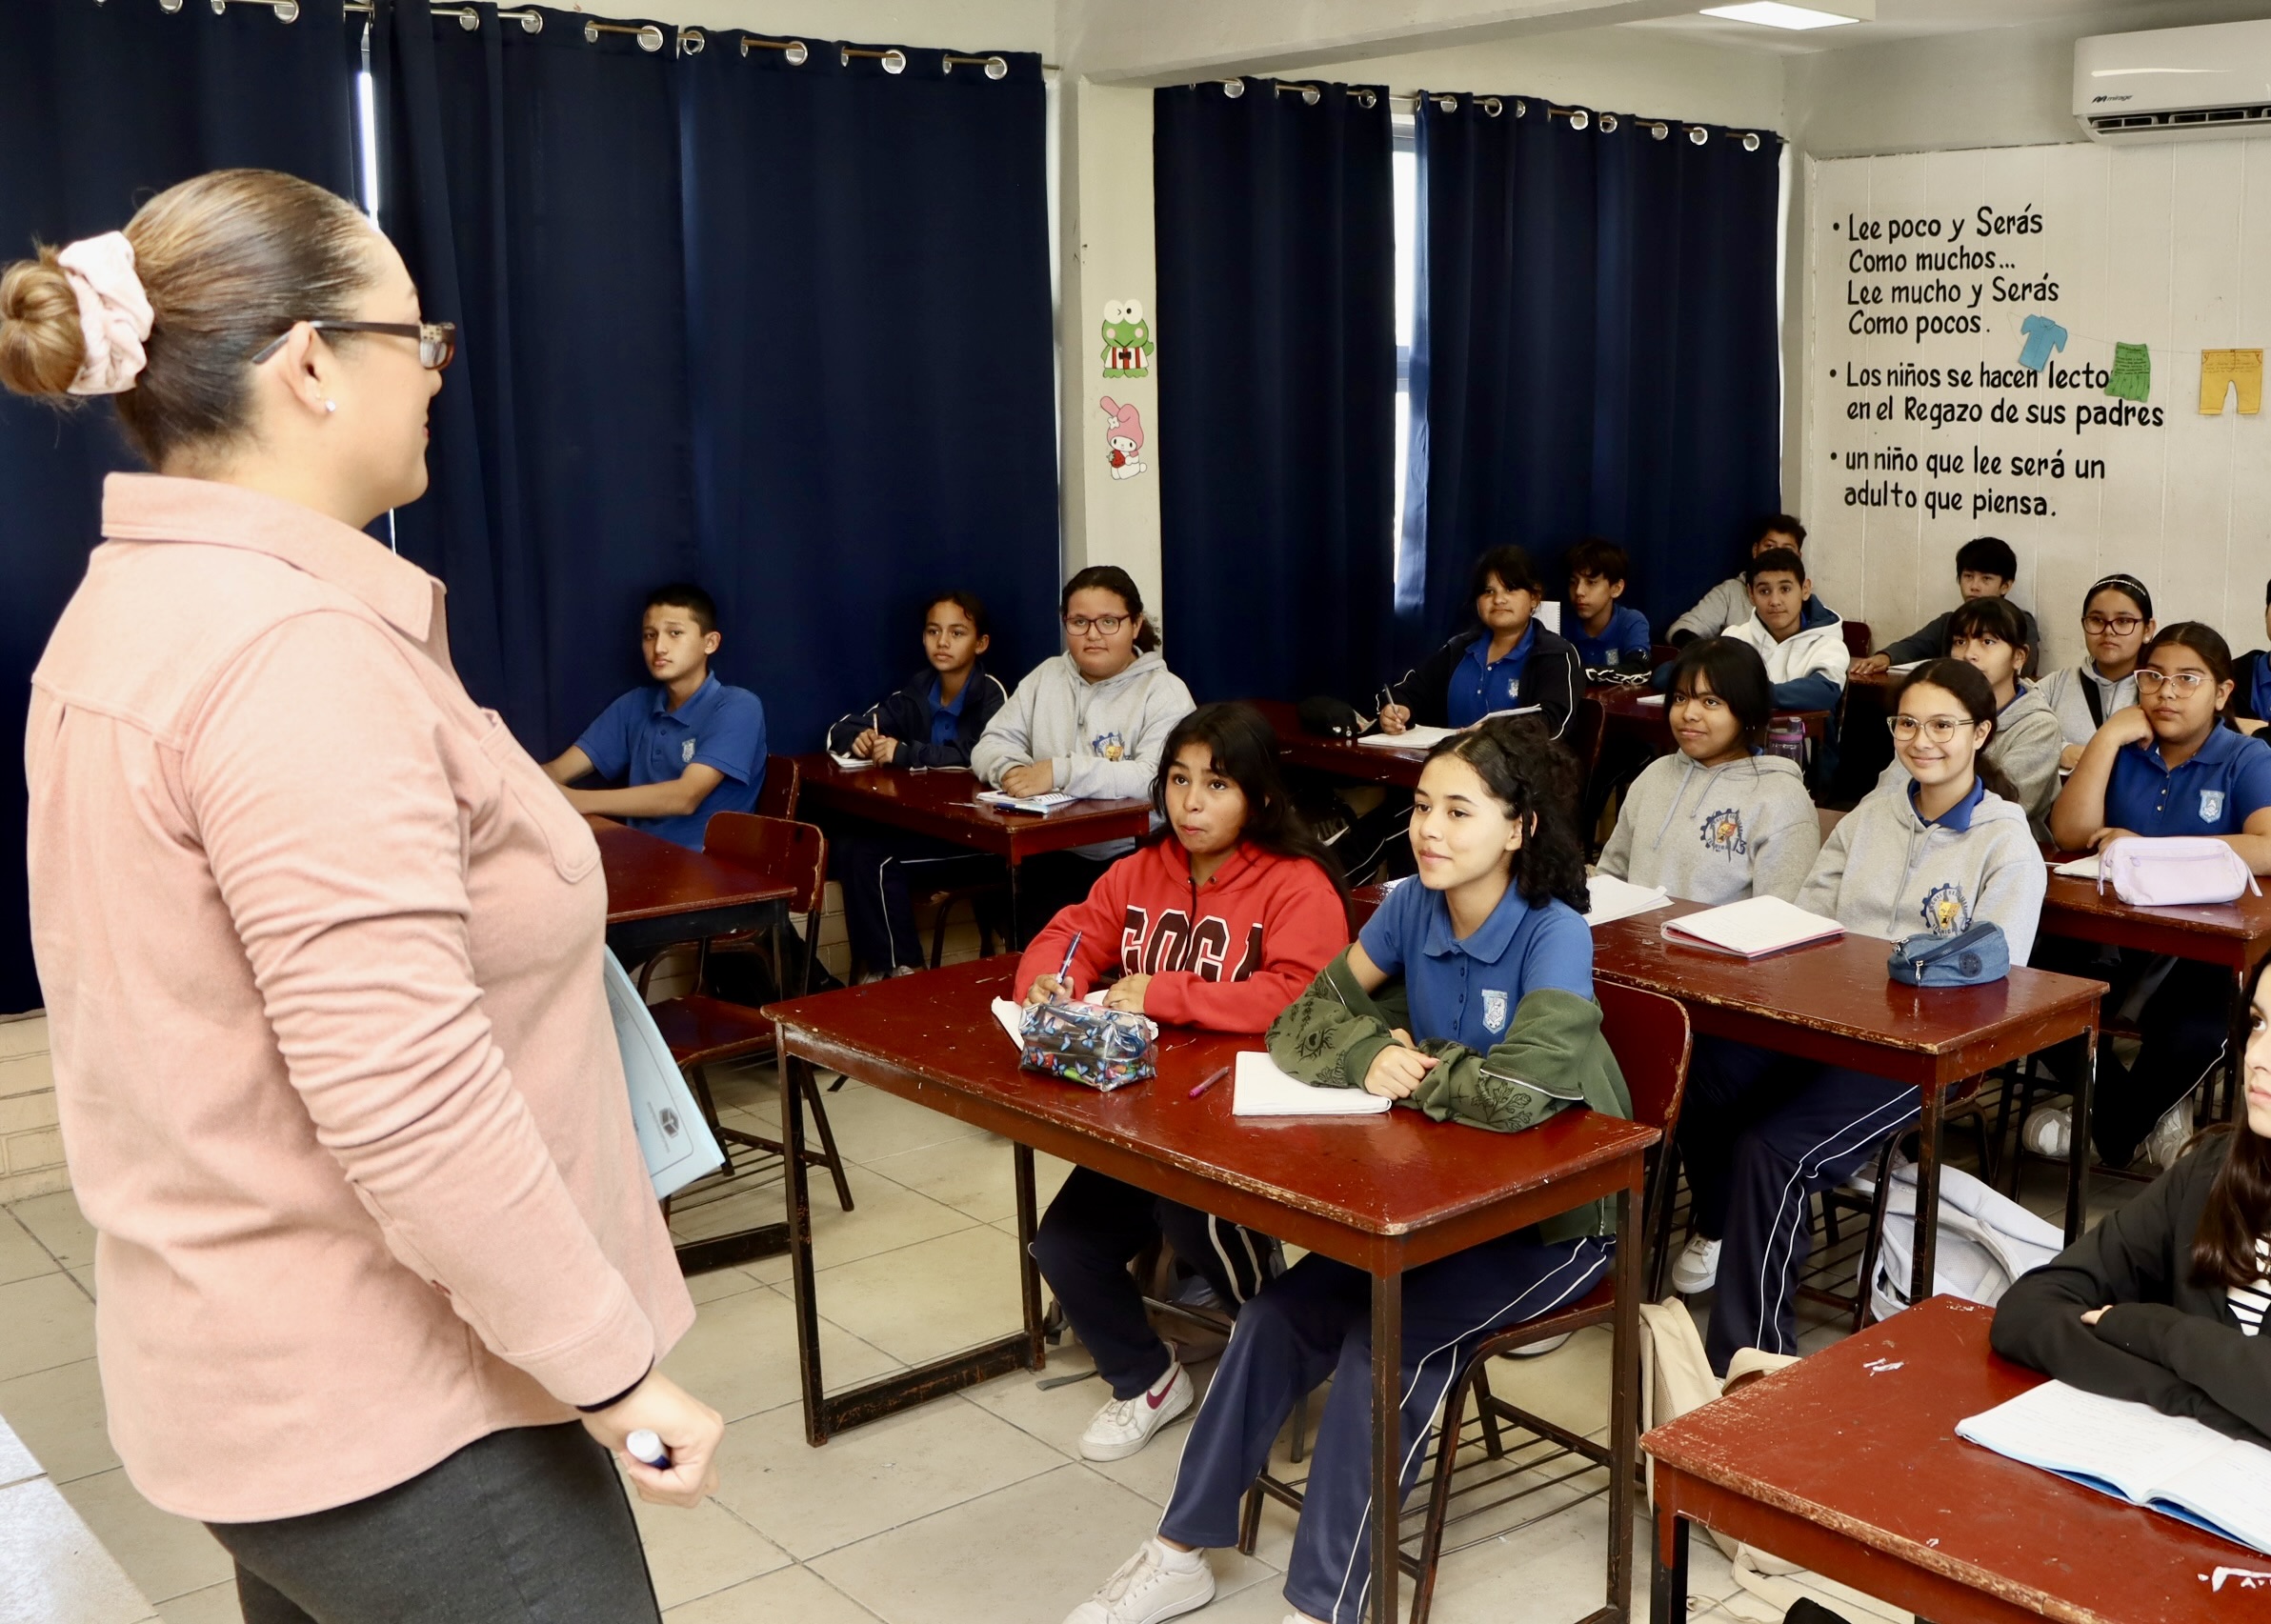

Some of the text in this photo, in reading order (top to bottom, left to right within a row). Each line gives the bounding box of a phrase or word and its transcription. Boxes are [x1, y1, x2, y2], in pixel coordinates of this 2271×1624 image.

[1848, 203, 2043, 245] Lee poco y Serás
[1849, 249, 1907, 273] Como
[1847, 272, 2060, 309] Lee mucho y Serás
[1848, 309, 1908, 335] Como
[1846, 361, 1881, 389] Los
[1887, 362, 1941, 389] niños
[1947, 368, 1974, 389] se
[1980, 361, 2038, 389] hacen
[2048, 360, 2113, 390] lecto
[1846, 394, 2164, 435] en el Regazo de sus padres
[1845, 445, 2105, 480] un niño que lee será un
[1844, 479, 2057, 520] adulto que piensa.
